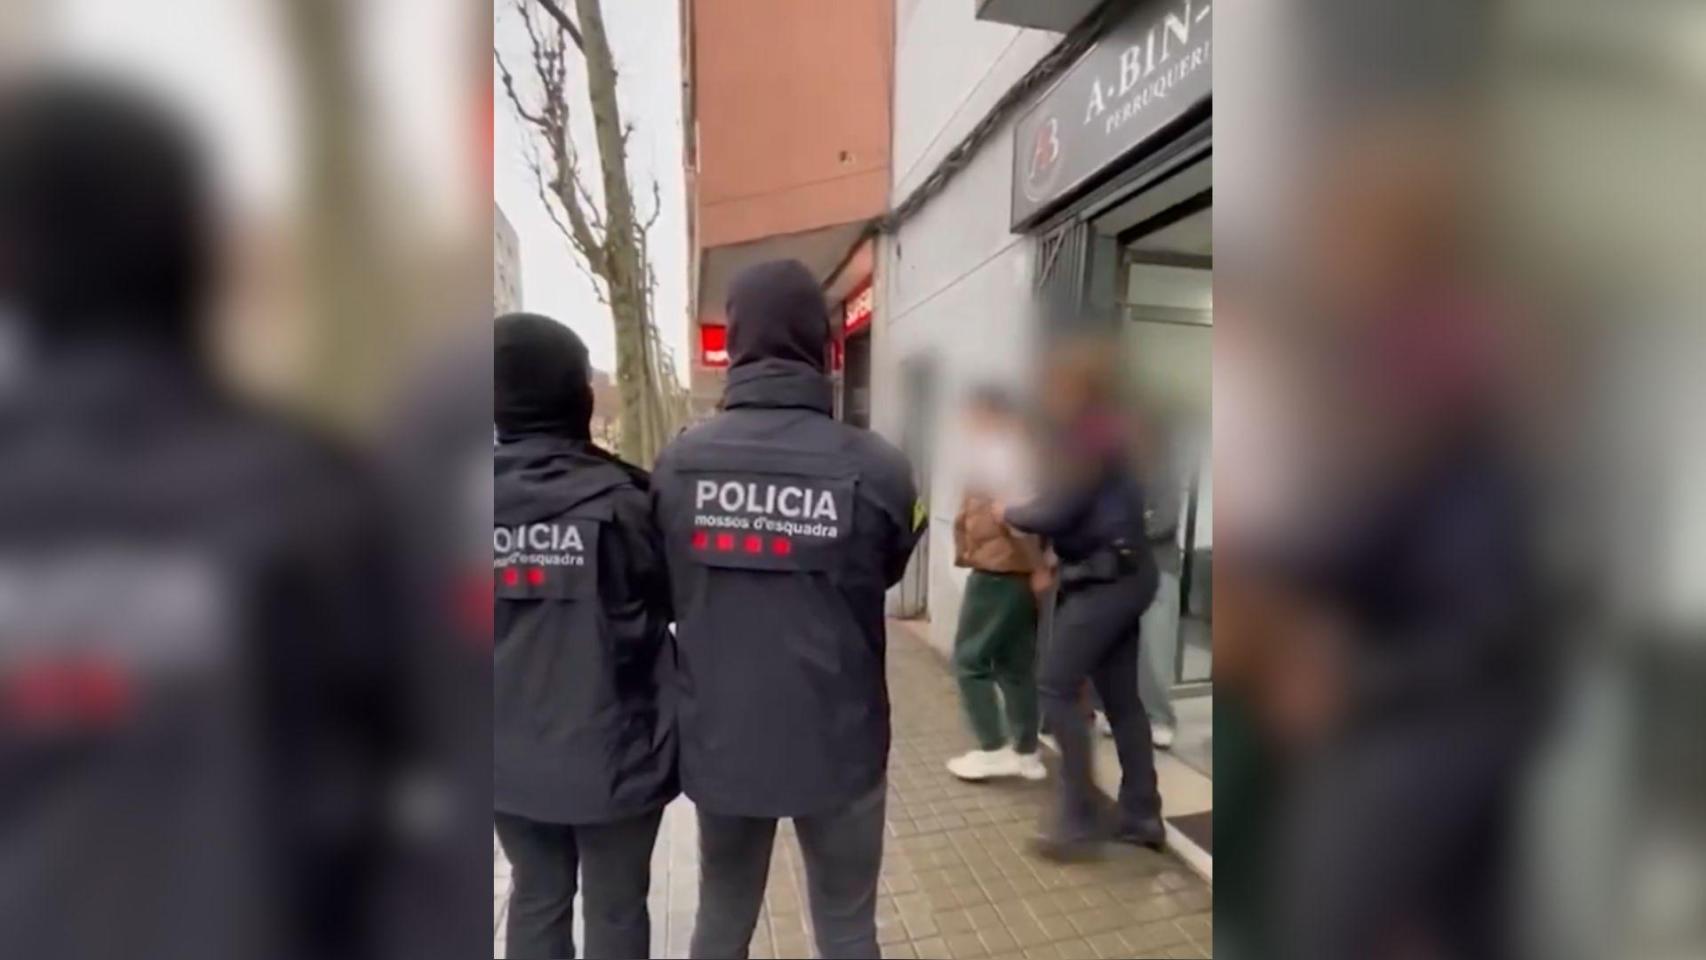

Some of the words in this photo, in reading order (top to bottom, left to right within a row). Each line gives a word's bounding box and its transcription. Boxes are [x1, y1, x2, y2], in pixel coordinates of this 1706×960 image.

[695, 479, 838, 521] POLICIA
[494, 523, 584, 553] OICIA
[694, 514, 750, 529] mossos
[753, 516, 838, 539] d'esquadra
